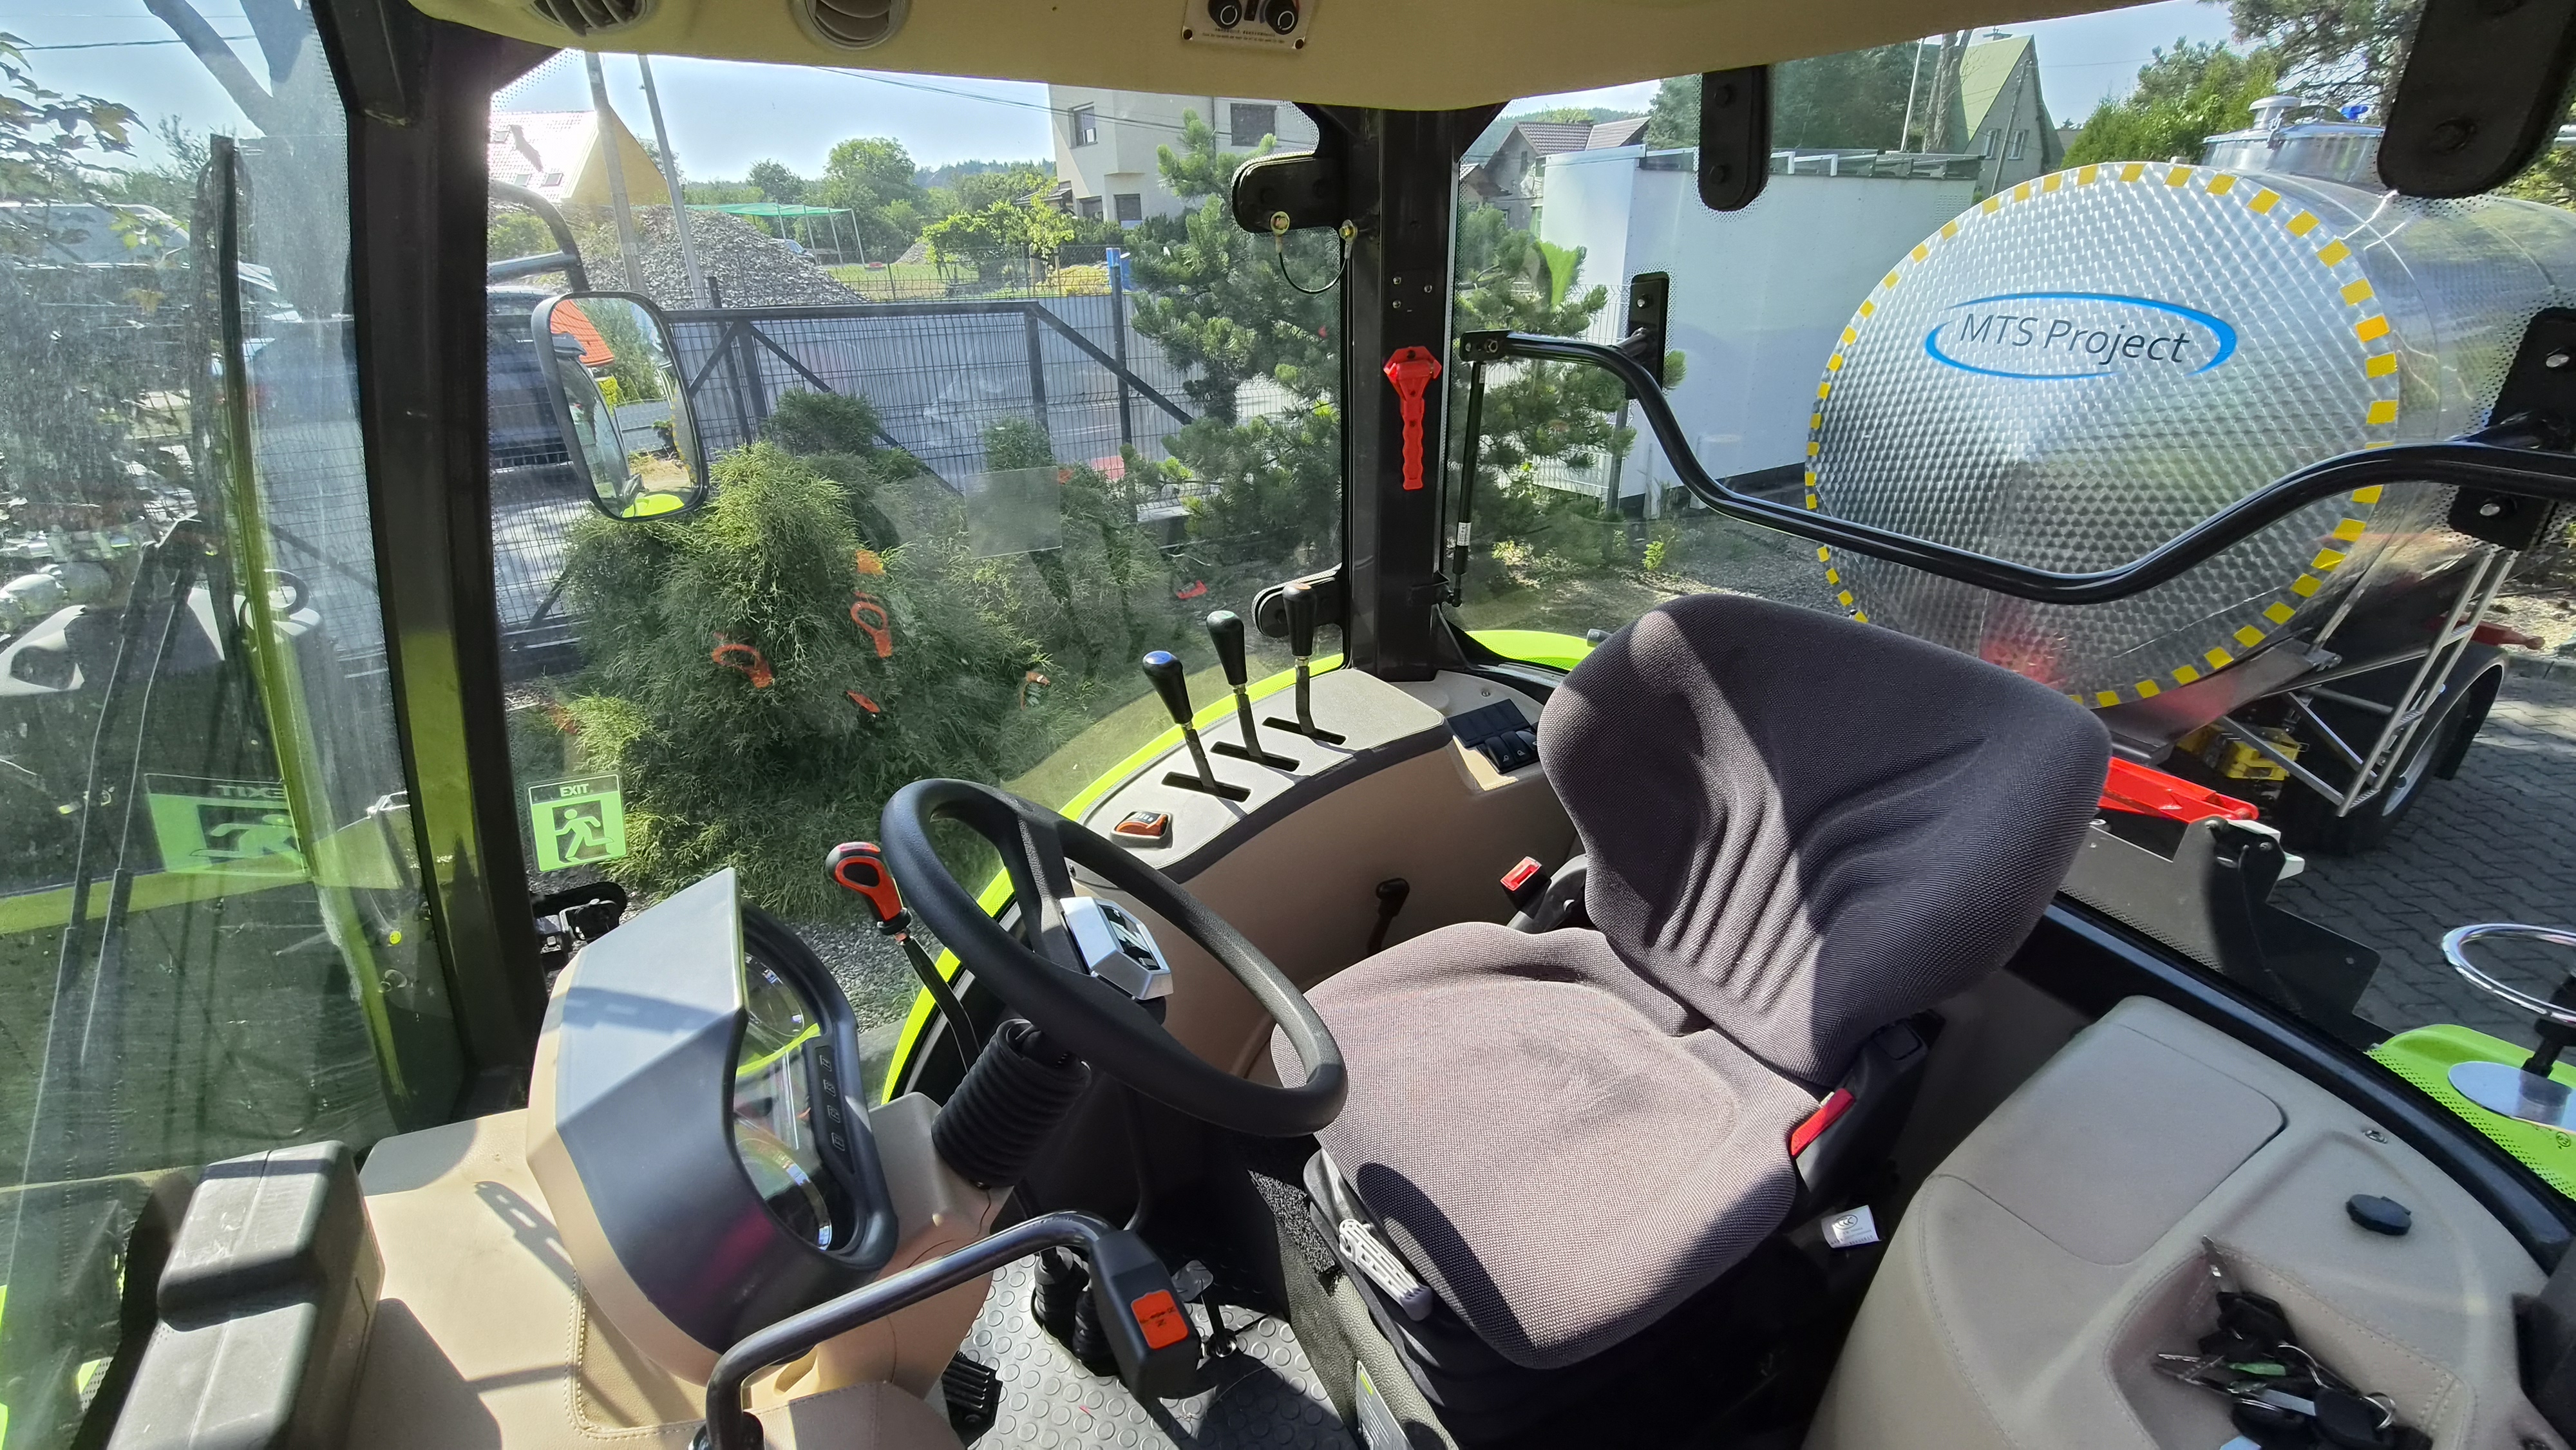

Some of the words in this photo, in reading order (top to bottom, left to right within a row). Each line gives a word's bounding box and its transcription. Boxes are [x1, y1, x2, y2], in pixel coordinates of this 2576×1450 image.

[1960, 313, 2038, 346] MTS
[2043, 319, 2190, 365] Project
[559, 783, 589, 797] EXIT
